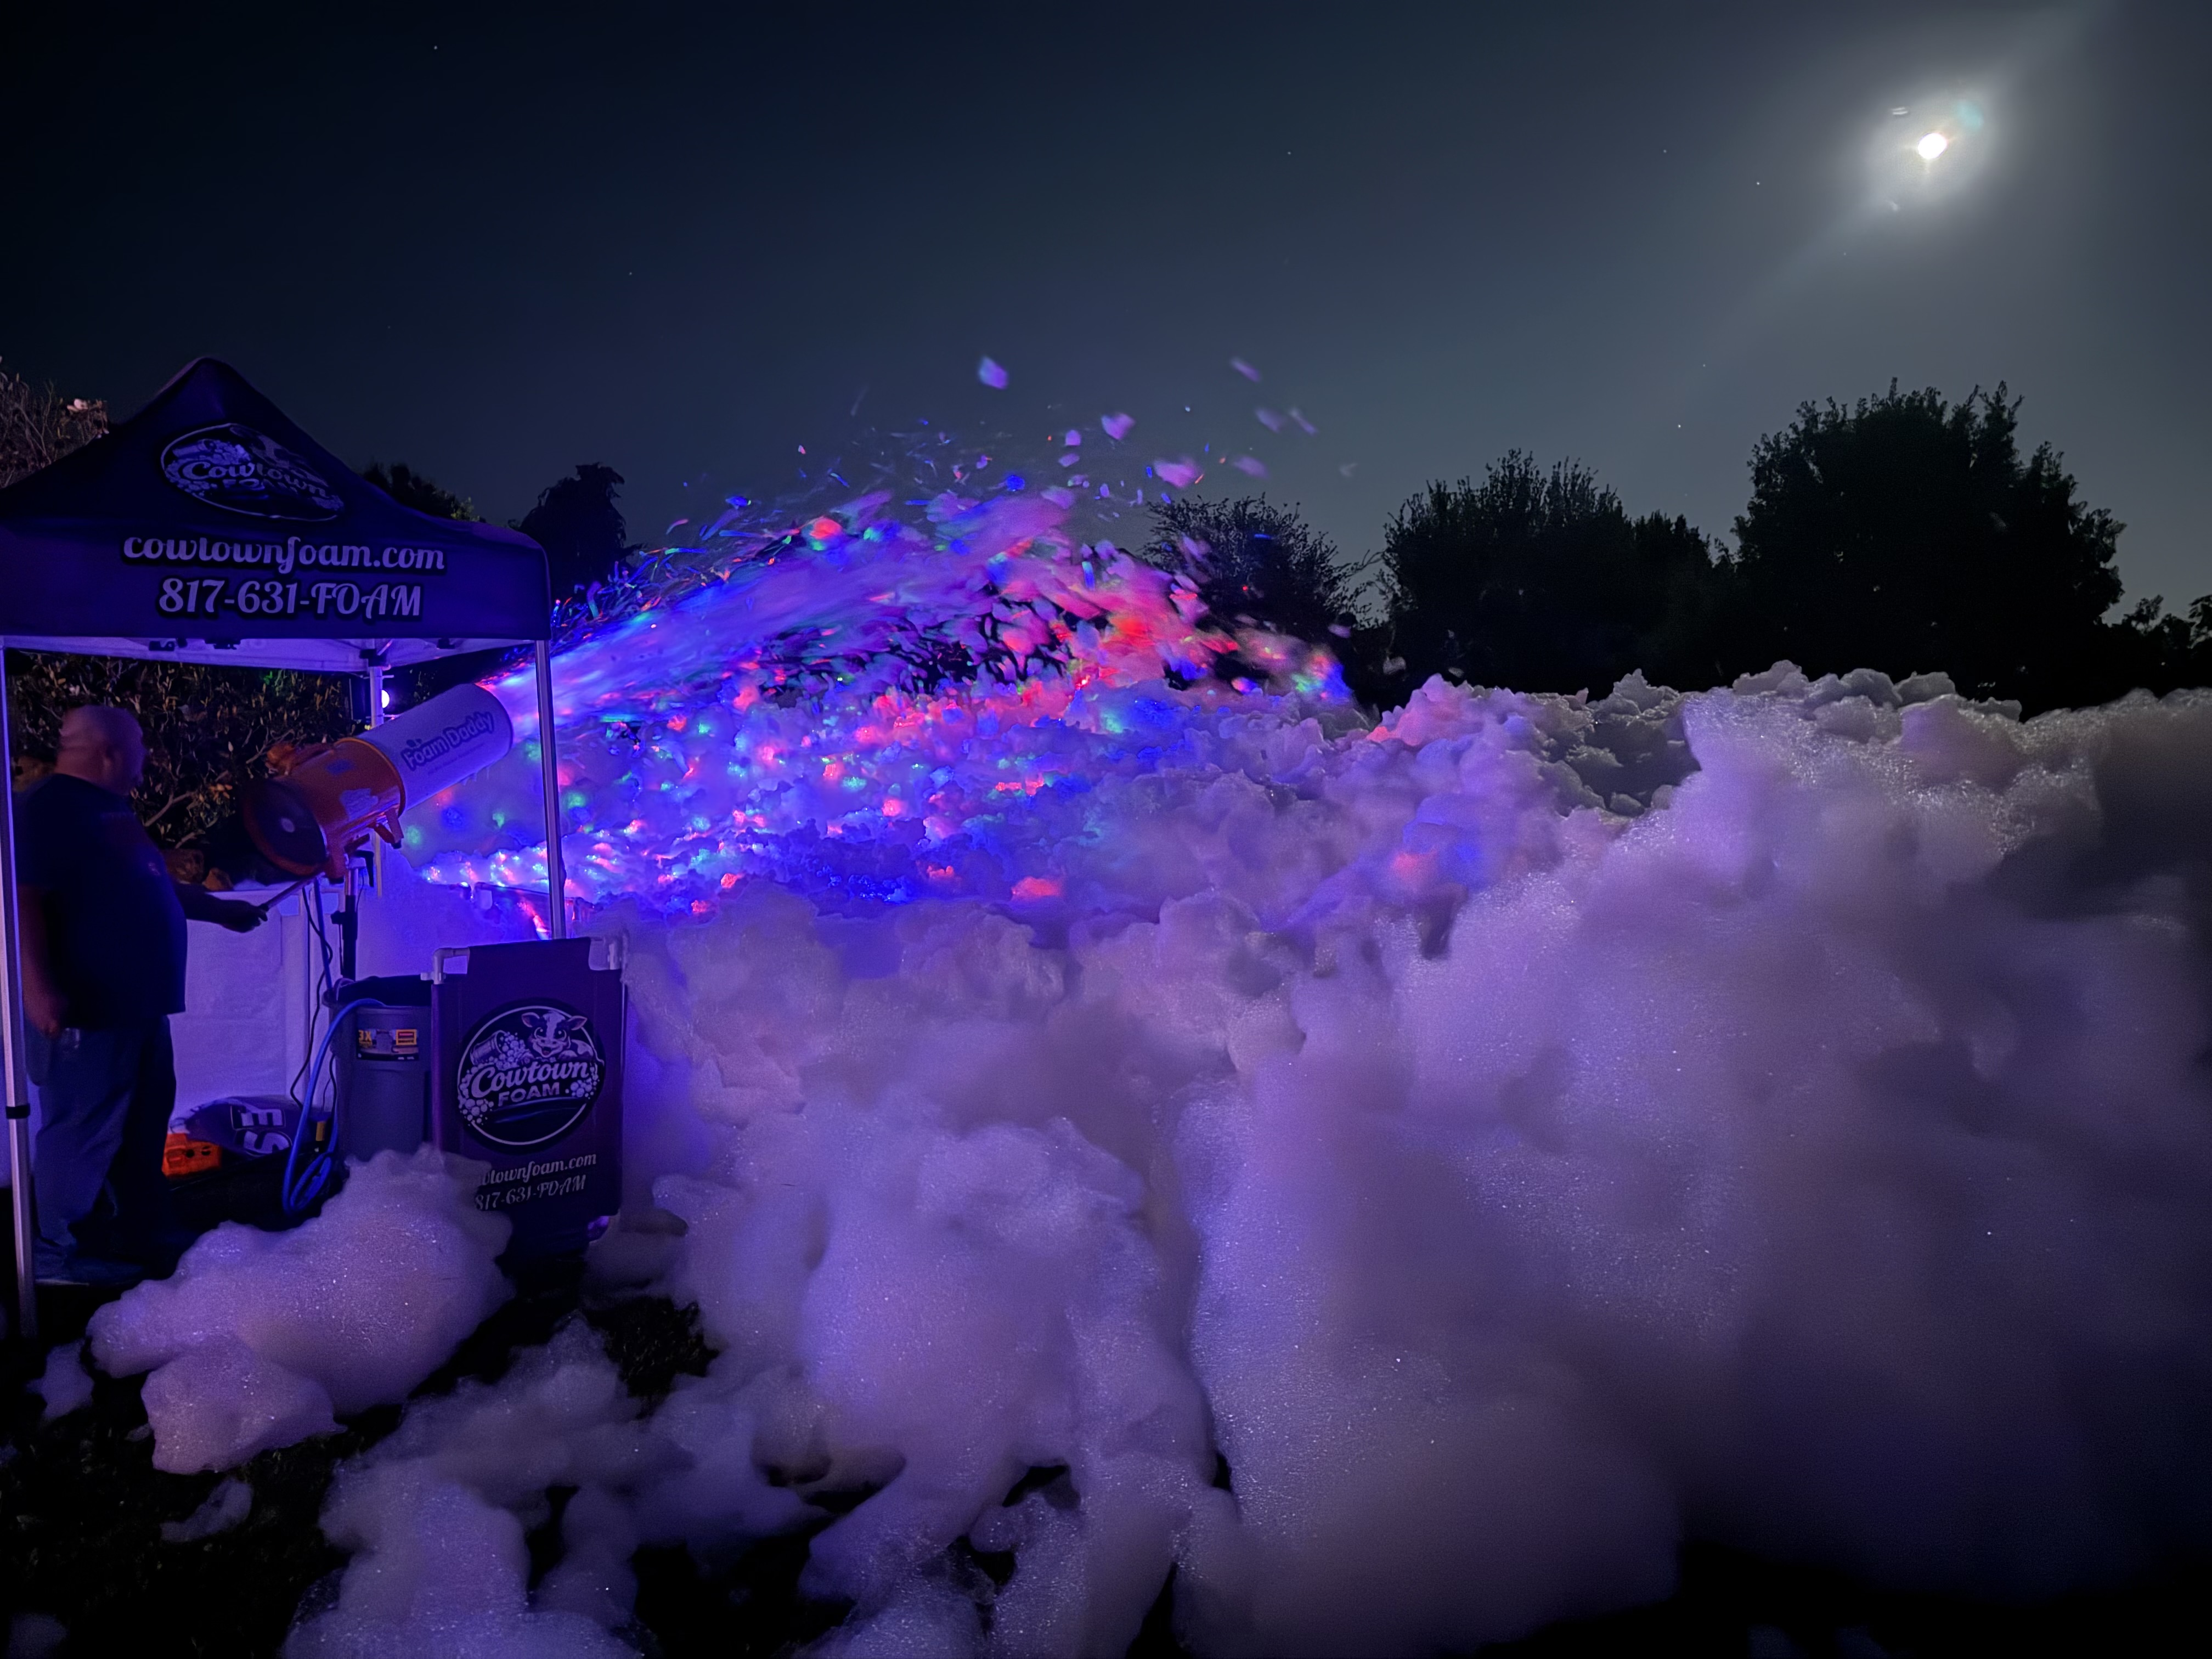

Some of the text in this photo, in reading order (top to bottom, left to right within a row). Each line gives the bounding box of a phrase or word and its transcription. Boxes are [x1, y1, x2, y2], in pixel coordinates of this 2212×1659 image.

[123, 536, 445, 574] cowtownfoam.com
[159, 577, 422, 619] 817-631-FOAM
[401, 736, 450, 771] Foam
[443, 712, 494, 748] Daddy
[471, 1062, 589, 1098] Cowtown
[498, 1082, 560, 1107] FOAM
[483, 1154, 597, 1186] wtownfoam.com
[475, 1174, 586, 1211] 817-631-FOAM
